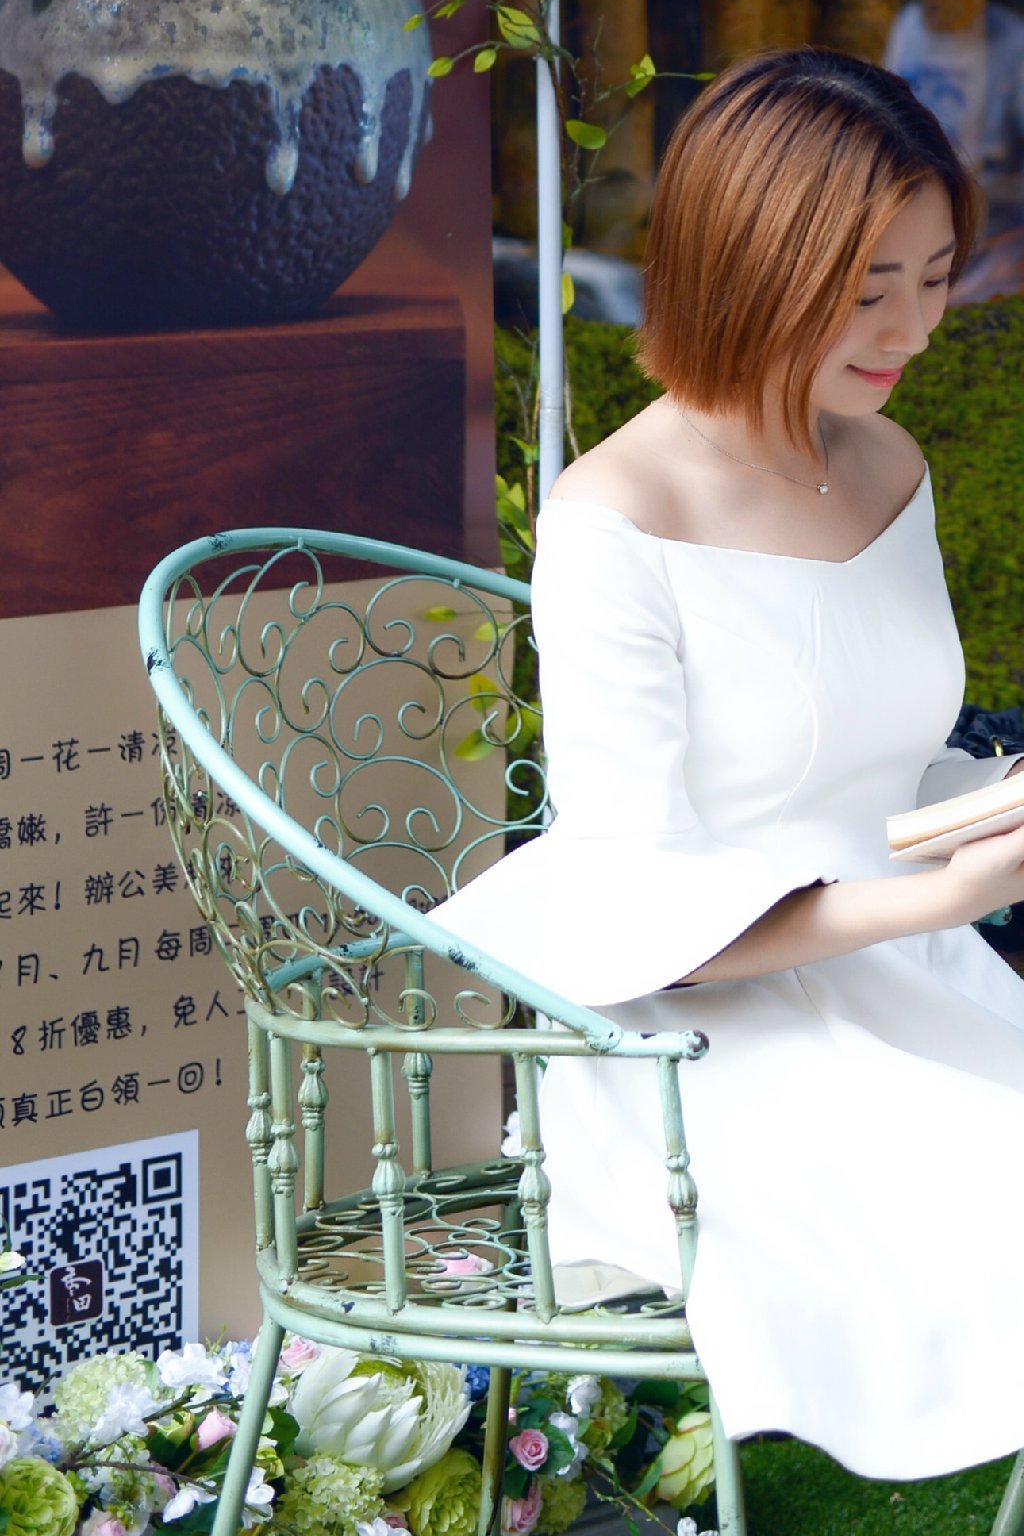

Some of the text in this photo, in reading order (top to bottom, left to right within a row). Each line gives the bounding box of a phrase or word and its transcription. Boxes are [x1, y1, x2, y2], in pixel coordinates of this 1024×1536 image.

[0, 1058, 222, 1129] 真正白領一回！
